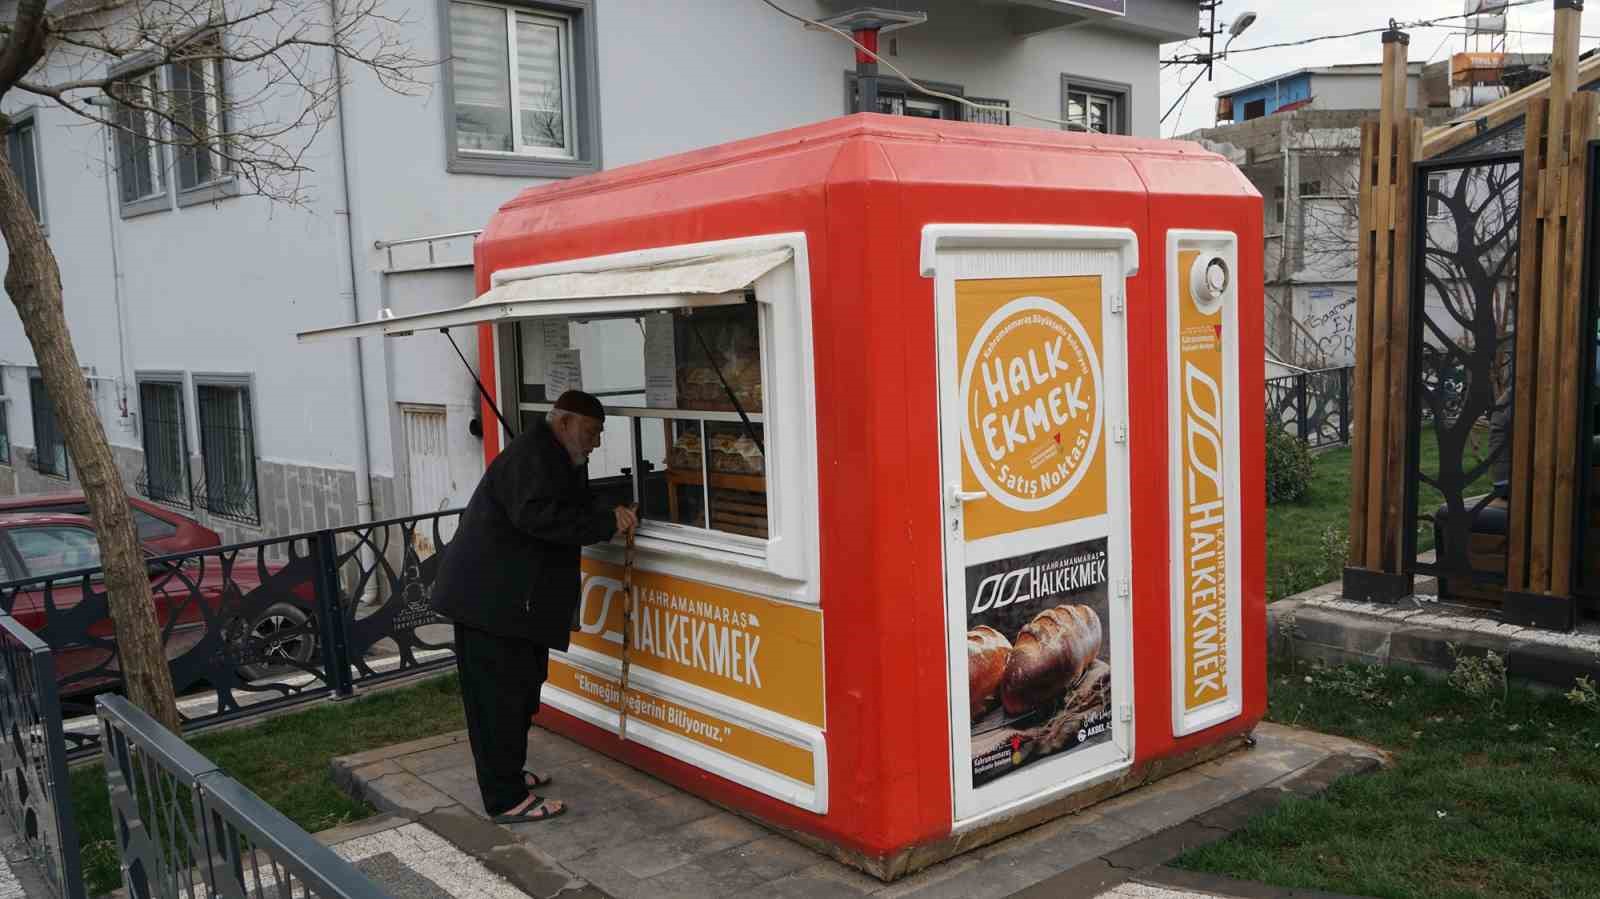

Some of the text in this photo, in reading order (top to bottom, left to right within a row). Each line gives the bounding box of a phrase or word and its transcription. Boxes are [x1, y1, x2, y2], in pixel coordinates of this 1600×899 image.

[981, 335, 1069, 408] HALK
[982, 376, 1089, 461] EKMEK
[998, 464, 1038, 499] Satış
[1040, 428, 1089, 492] Noktası
[640, 587, 748, 629] KAHRAMANMARAŞ
[1030, 559, 1106, 600] HALKEKMEK
[1189, 500, 1224, 698] HALKEKMEK
[624, 696, 666, 721] eğerini
